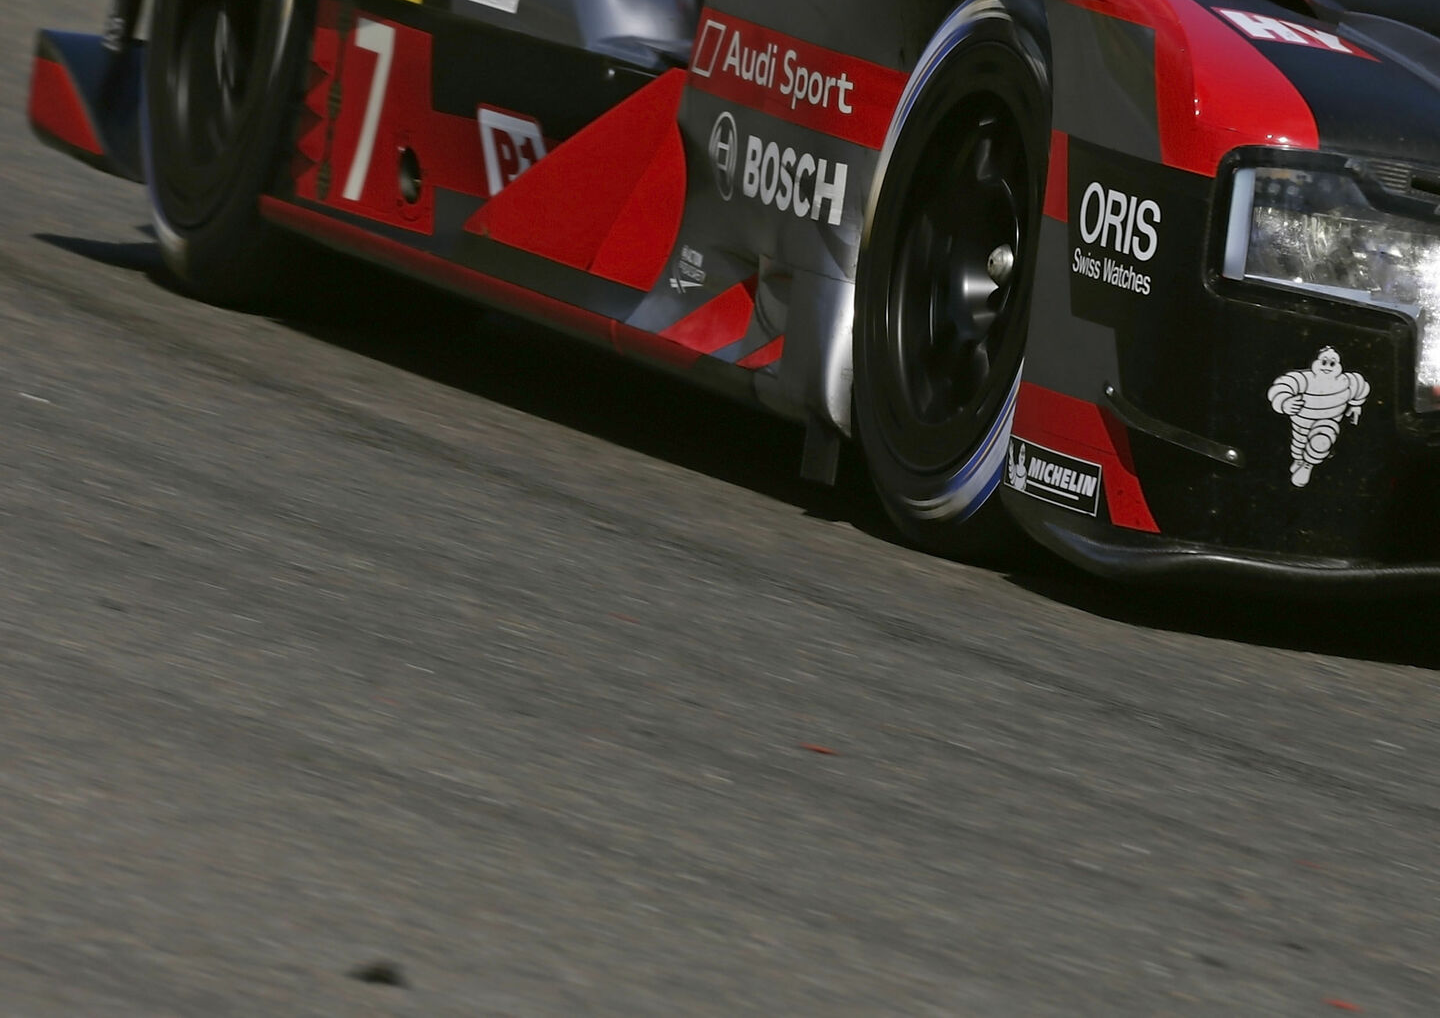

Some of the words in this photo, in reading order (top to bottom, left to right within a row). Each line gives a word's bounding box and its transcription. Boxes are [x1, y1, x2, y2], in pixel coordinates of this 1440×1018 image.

[1219, 8, 1354, 54] HY
[343, 17, 396, 202] 7
[722, 30, 779, 89] Audi
[779, 48, 854, 114] Sport
[743, 134, 848, 226] BOSCH
[1079, 181, 1162, 262] ORIS
[1072, 247, 1102, 280] Swiss
[1102, 257, 1152, 296] Watches
[1027, 456, 1098, 498] MICHELIN
